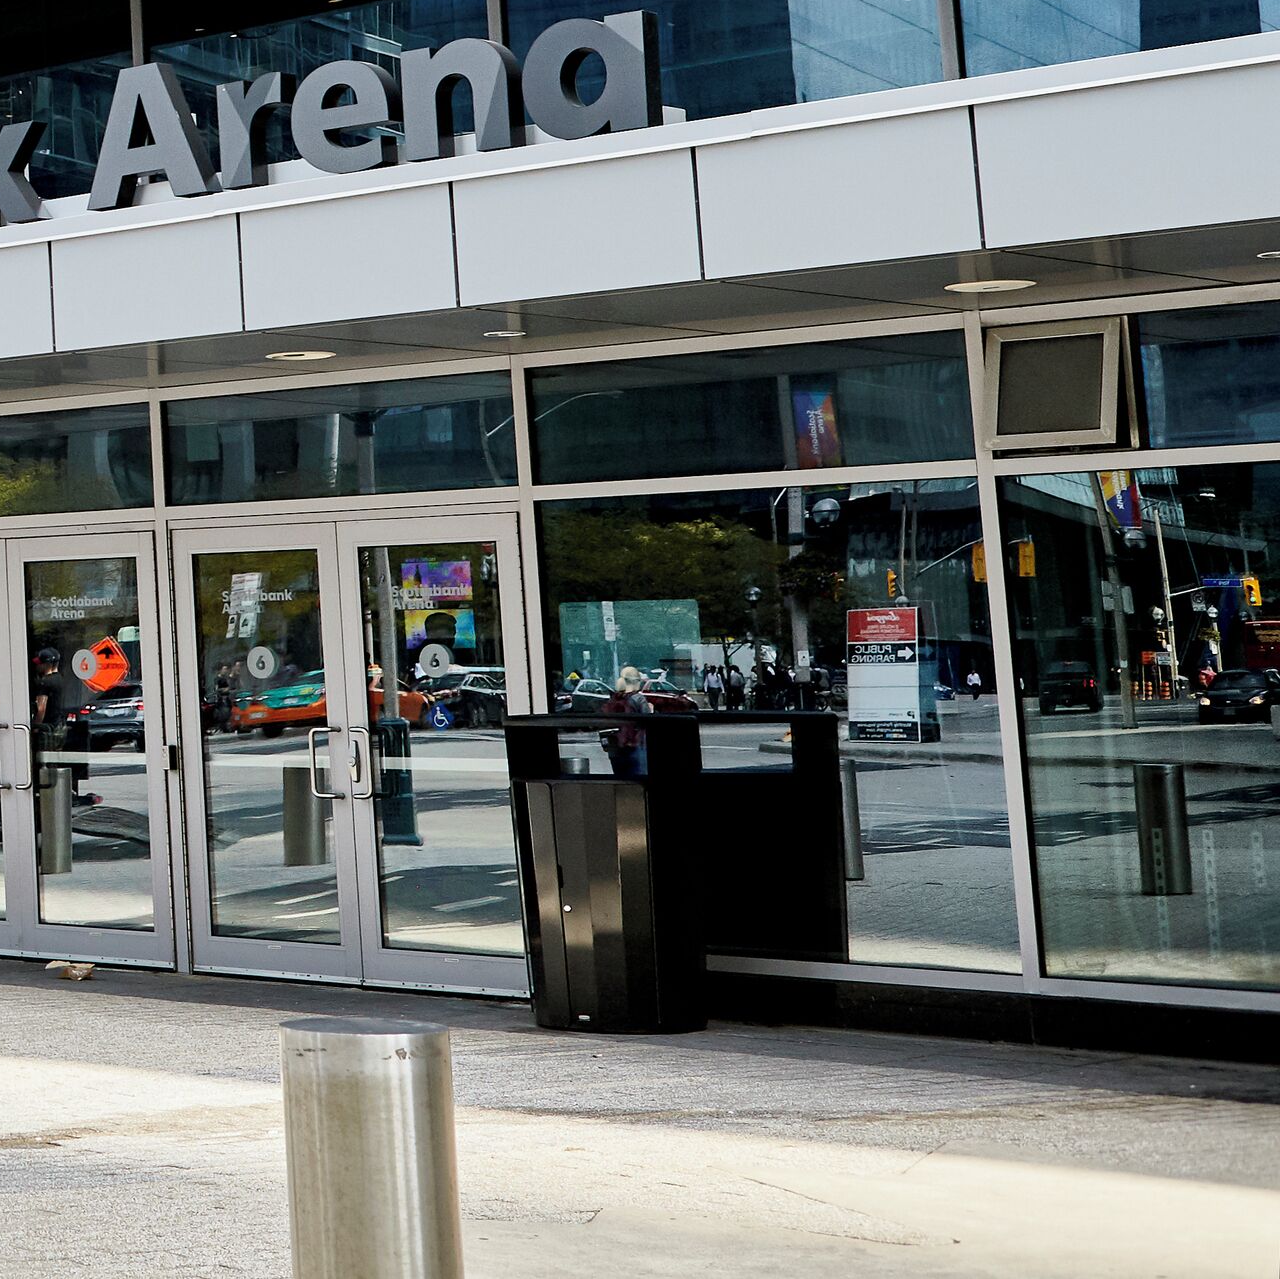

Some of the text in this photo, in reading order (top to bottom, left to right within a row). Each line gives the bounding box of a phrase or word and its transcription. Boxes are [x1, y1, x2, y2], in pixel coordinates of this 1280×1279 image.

[88, 10, 662, 211] Arena
[50, 596, 114, 607] Scotiabank
[50, 608, 86, 619] Arena
[79, 656, 89, 672] 6
[255, 655, 266, 670] 6
[429, 654, 440, 669] 6
